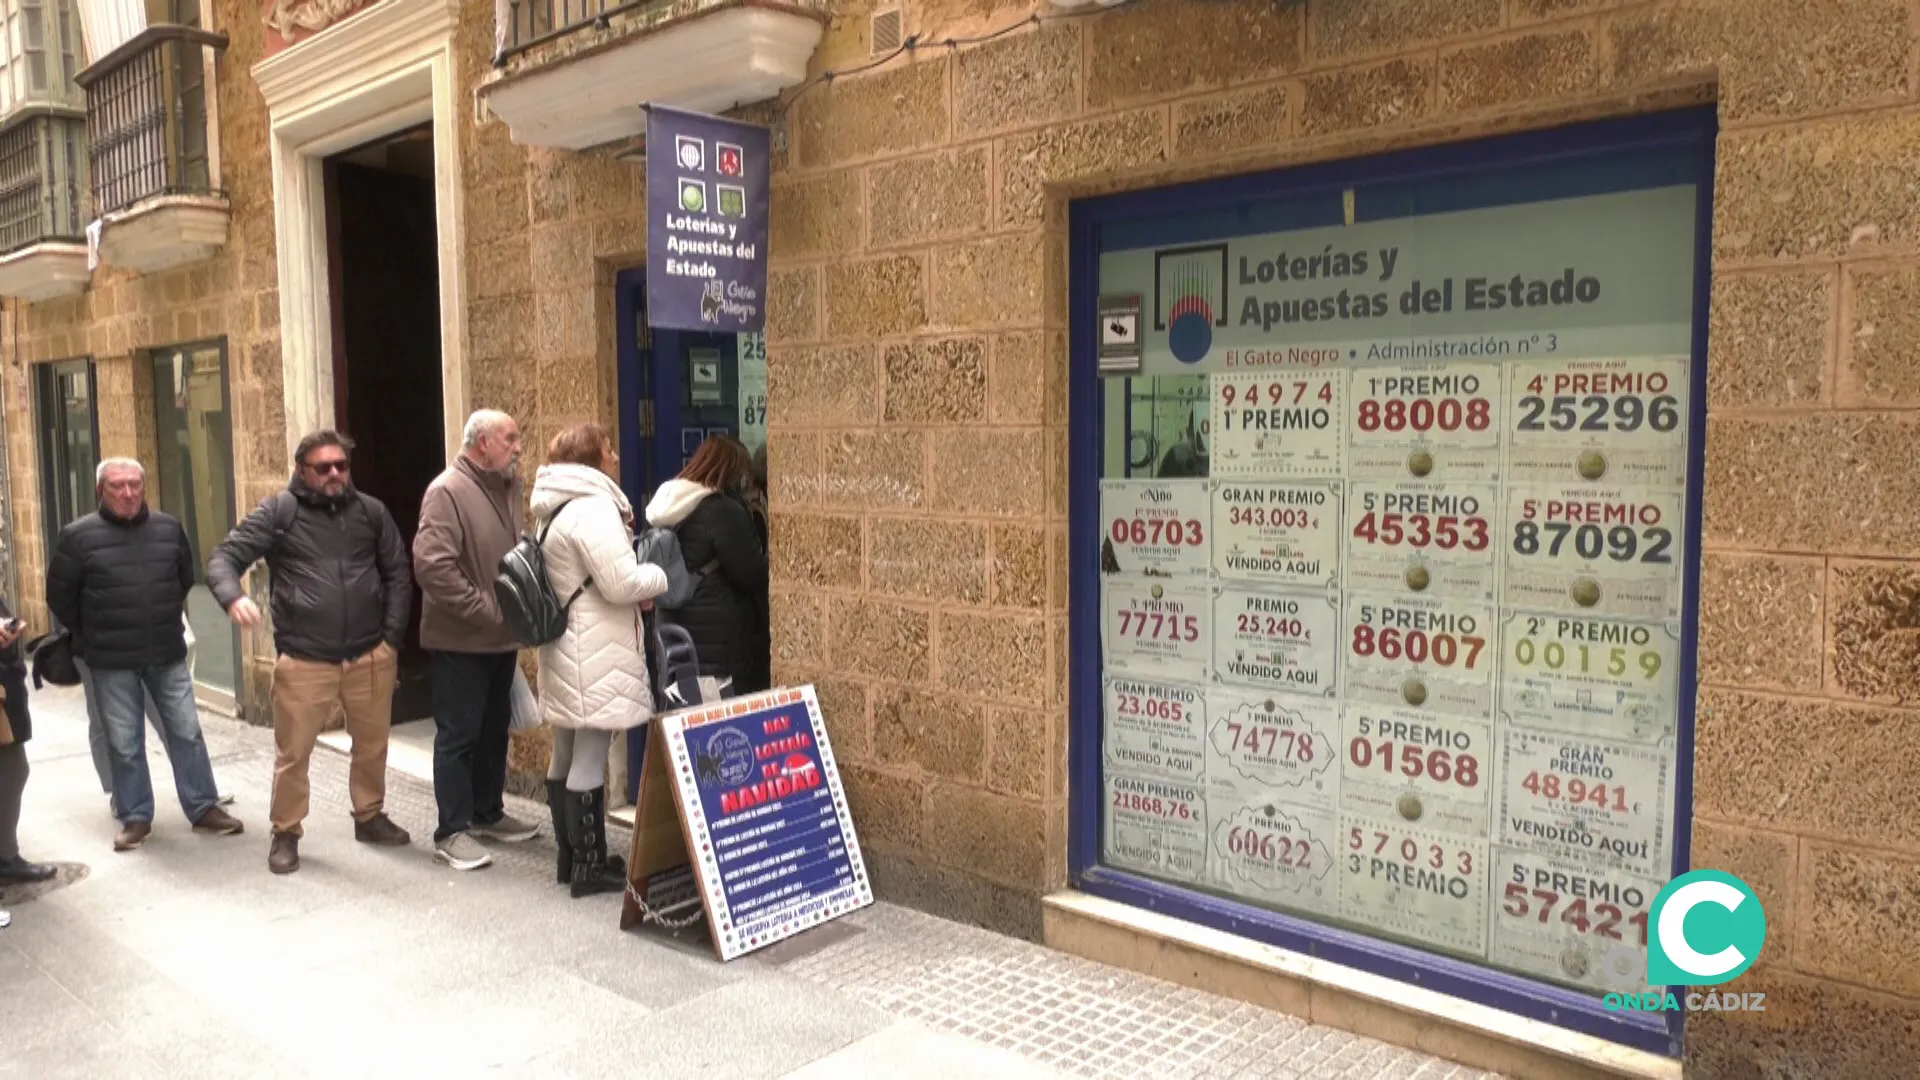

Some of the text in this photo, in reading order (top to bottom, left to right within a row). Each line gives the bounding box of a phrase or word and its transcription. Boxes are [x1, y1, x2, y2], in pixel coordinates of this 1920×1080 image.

[729, 224, 737, 240] y
[667, 235, 755, 260] Apuestas del
[666, 259, 717, 278] Estado
[1239, 245, 1399, 284] Loterías y
[1239, 268, 1602, 332] Apuestas del Estado
[1226, 350, 1240, 366] El
[1244, 347, 1283, 366] Gato
[1287, 346, 1340, 369] Negro
[1367, 337, 1511, 362] Administración
[1546, 334, 1558, 352] 3
[1385, 375, 1480, 396] PREMIO
[1554, 372, 1668, 394] PREMIO
[1242, 408, 1329, 430] PREMIO
[1358, 397, 1490, 432] 88008
[1517, 394, 1678, 432] 25296
[1223, 488, 1325, 505] GRAN PREMIO
[1384, 493, 1479, 515] PREMIO
[1230, 506, 1308, 528] 343.003
[1547, 501, 1661, 525] PREMIO
[1112, 518, 1203, 546] 06703
[1353, 512, 1489, 551] 45353
[1513, 520, 1672, 564] 87092
[1226, 556, 1320, 576] VENDIDO AQUÍ
[1247, 597, 1299, 615] PREMIO
[1118, 611, 1199, 642] 77715
[1237, 613, 1302, 637] 25.240
[1381, 610, 1476, 634] PREMIO
[1558, 620, 1650, 645] PREMIO
[1352, 624, 1486, 669] 86007
[1227, 661, 1318, 684] VENDIDO AQUÍ
[1114, 681, 1194, 703] GRAN PREMIO
[1117, 695, 1182, 721] 23.065
[1254, 713, 1293, 727] PREMIO
[763, 715, 791, 734] HAY
[1379, 720, 1470, 751] PREMIO
[754, 732, 811, 760] LOTERÍA
[1227, 721, 1314, 763] 74778
[1115, 748, 1161, 766] VENDIDO
[1349, 736, 1479, 788] 01568
[1559, 746, 1604, 766] GRAN
[761, 761, 781, 778] DE
[1550, 758, 1614, 780] PREMIO
[720, 768, 820, 816] NAVIDAD
[1114, 777, 1194, 802] GRAN PREMIO
[1522, 770, 1629, 813] 48.941
[1113, 791, 1189, 819] 21868,76
[1254, 817, 1292, 833] PREMIO
[1228, 826, 1312, 869] 60622
[1511, 817, 1594, 847] VENDIDO
[1599, 835, 1649, 859] AQUÍ
[1115, 843, 1161, 863] VENDIDO
[1370, 859, 1468, 899] PREMIO
[1534, 869, 1644, 908] PREMIO
[1503, 883, 1648, 945] 57421
